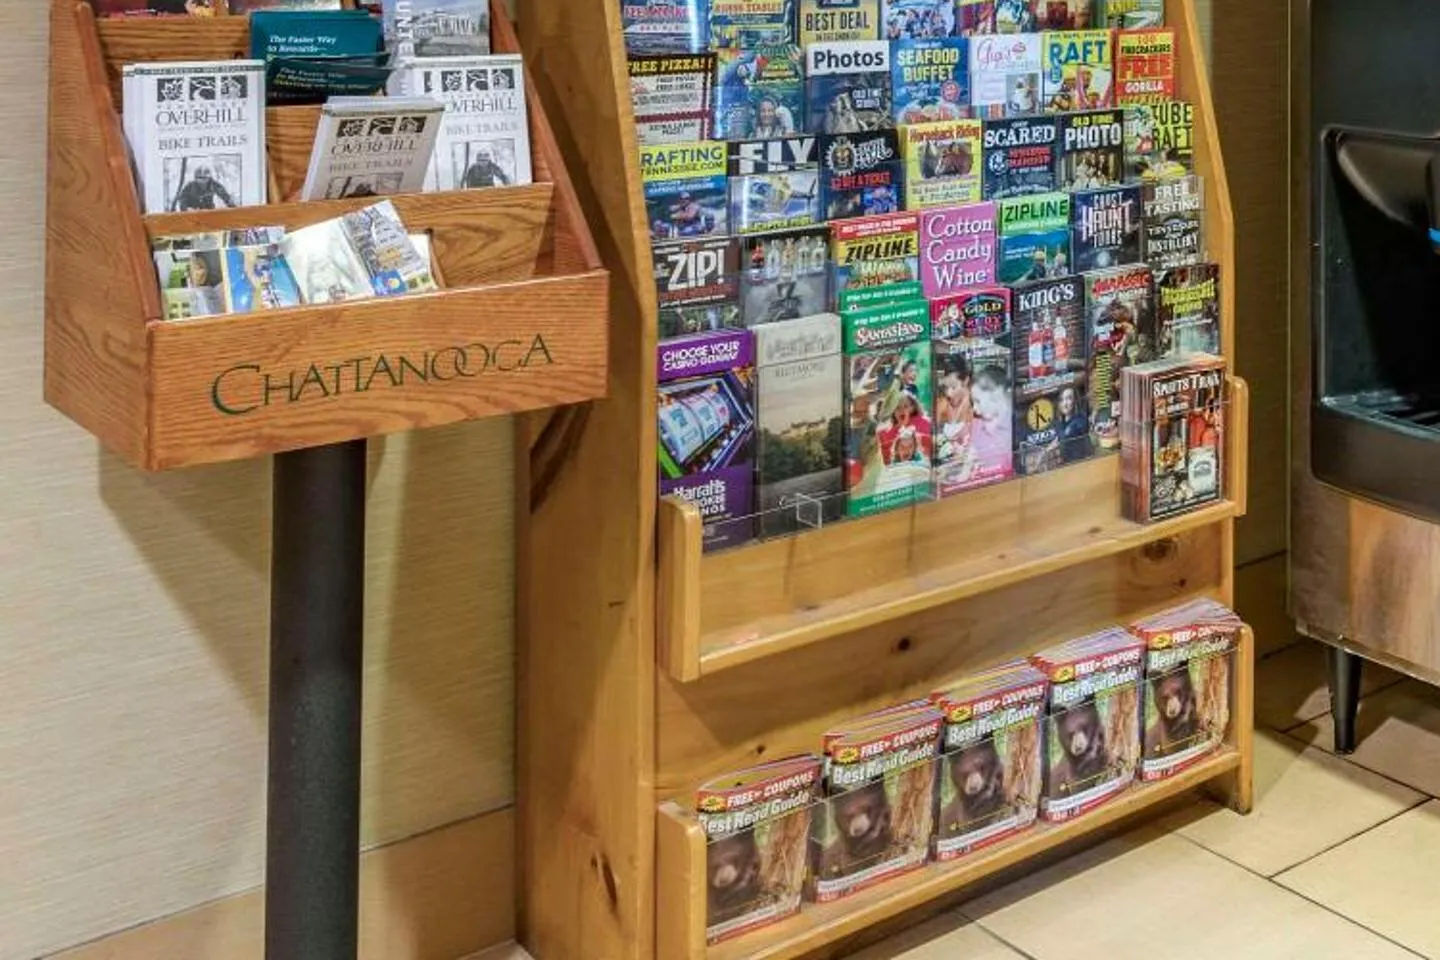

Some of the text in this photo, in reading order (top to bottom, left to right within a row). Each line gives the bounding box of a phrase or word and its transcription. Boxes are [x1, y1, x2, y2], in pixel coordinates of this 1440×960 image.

[805, 11, 871, 32] BEST DEAL
[813, 50, 884, 69] Photos
[896, 47, 959, 65] SEAFOOD
[1050, 40, 1107, 67] RAFT
[903, 65, 954, 82] BUFFET
[156, 106, 248, 127] OVERHILL
[1151, 103, 1192, 126] TUBE
[158, 138, 191, 152] BIKE
[984, 125, 1056, 147] SCARED
[1065, 122, 1122, 150] PHOTO
[641, 146, 723, 166] RAFTING
[740, 138, 815, 173] FLY
[1155, 181, 1190, 200] FREE
[1004, 200, 1069, 222] ZIPLINE
[928, 214, 993, 238] Cotton
[846, 238, 914, 263] ZIPLINE
[927, 235, 992, 264] Candy
[668, 248, 724, 291] ZIP!
[933, 263, 987, 289] Wine
[965, 302, 1002, 315] GOLD
[1019, 283, 1075, 311] KING'S
[663, 340, 741, 363] CHOOSE YOUR
[211, 333, 554, 417] CHATTANOOGA
[1102, 648, 1140, 669] COUPONS
[1053, 683, 1080, 704] Best
[1109, 667, 1138, 688] Guide
[1007, 701, 1041, 725] Guide
[893, 723, 938, 749] COUPONS
[833, 765, 865, 784] Best
[900, 743, 935, 765] Guide
[771, 791, 810, 813] Guide
